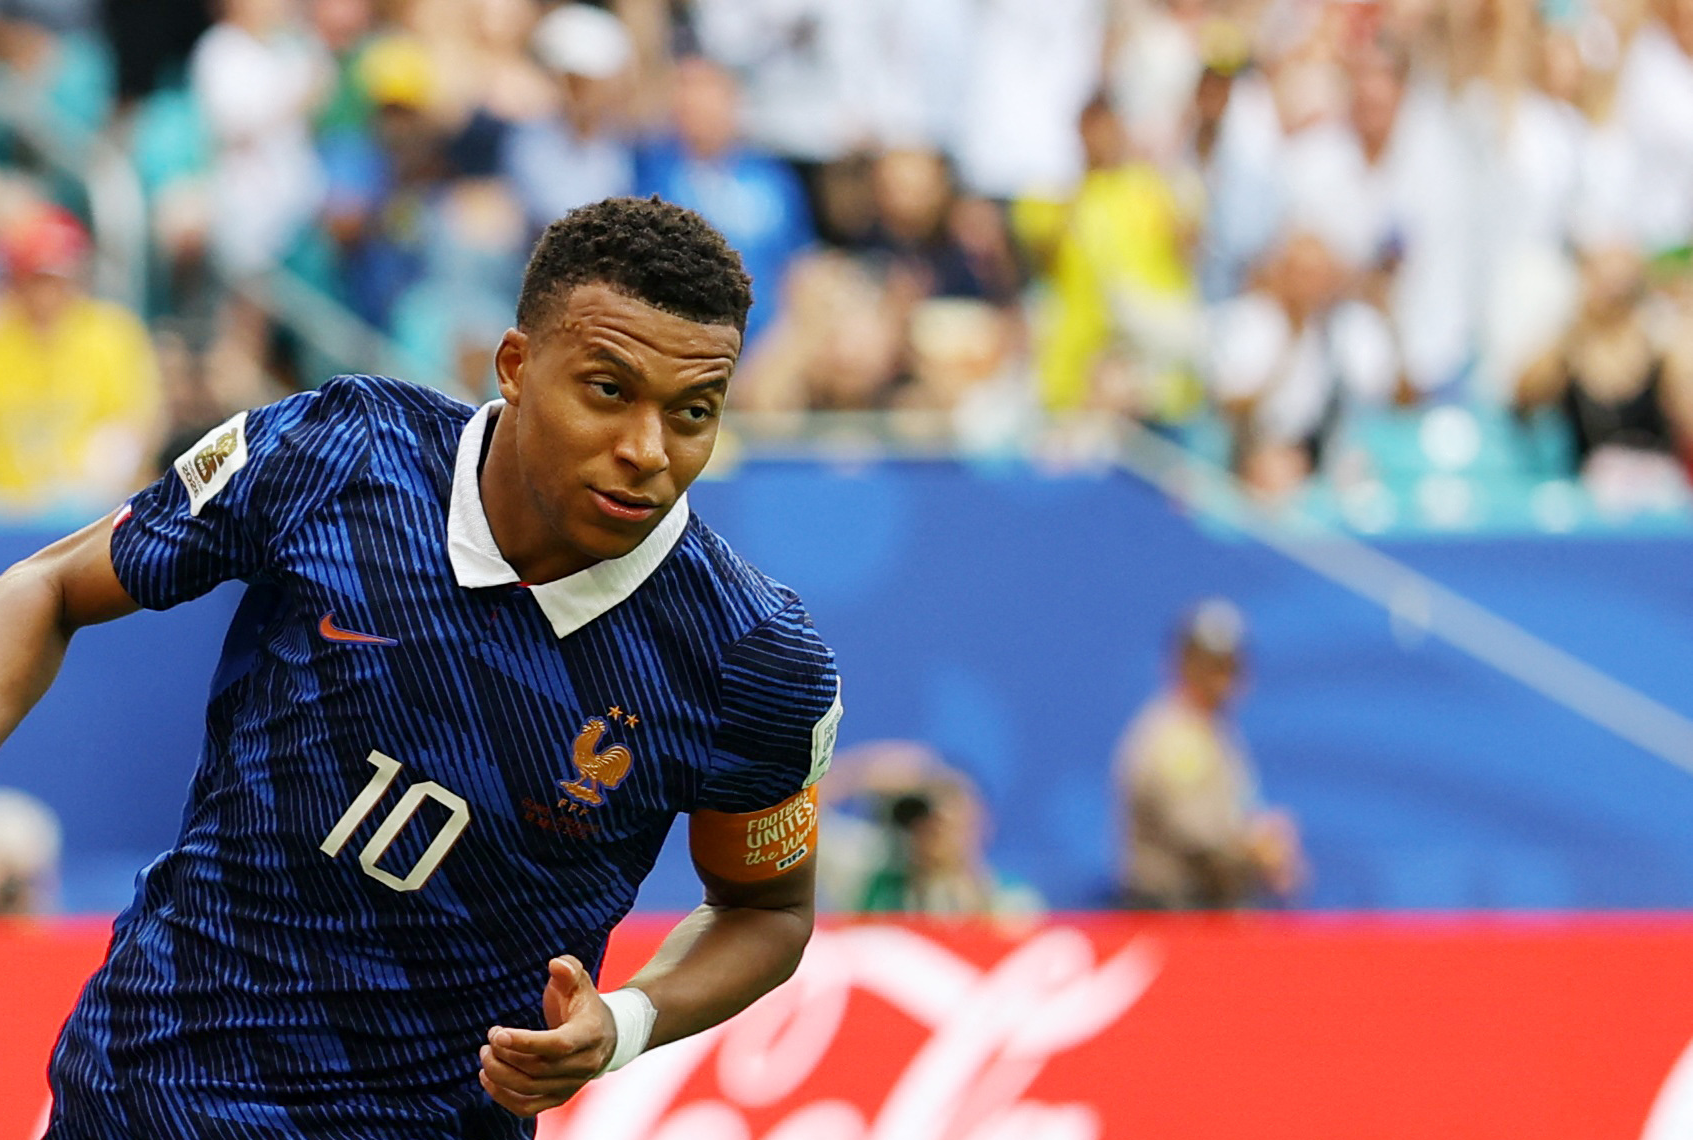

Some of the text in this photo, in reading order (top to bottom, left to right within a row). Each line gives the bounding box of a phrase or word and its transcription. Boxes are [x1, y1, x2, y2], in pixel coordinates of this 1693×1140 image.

[319, 749, 471, 892] 10
[747, 797, 814, 848] UNITES
[742, 849, 779, 865] the
[779, 848, 805, 868] FIFA
